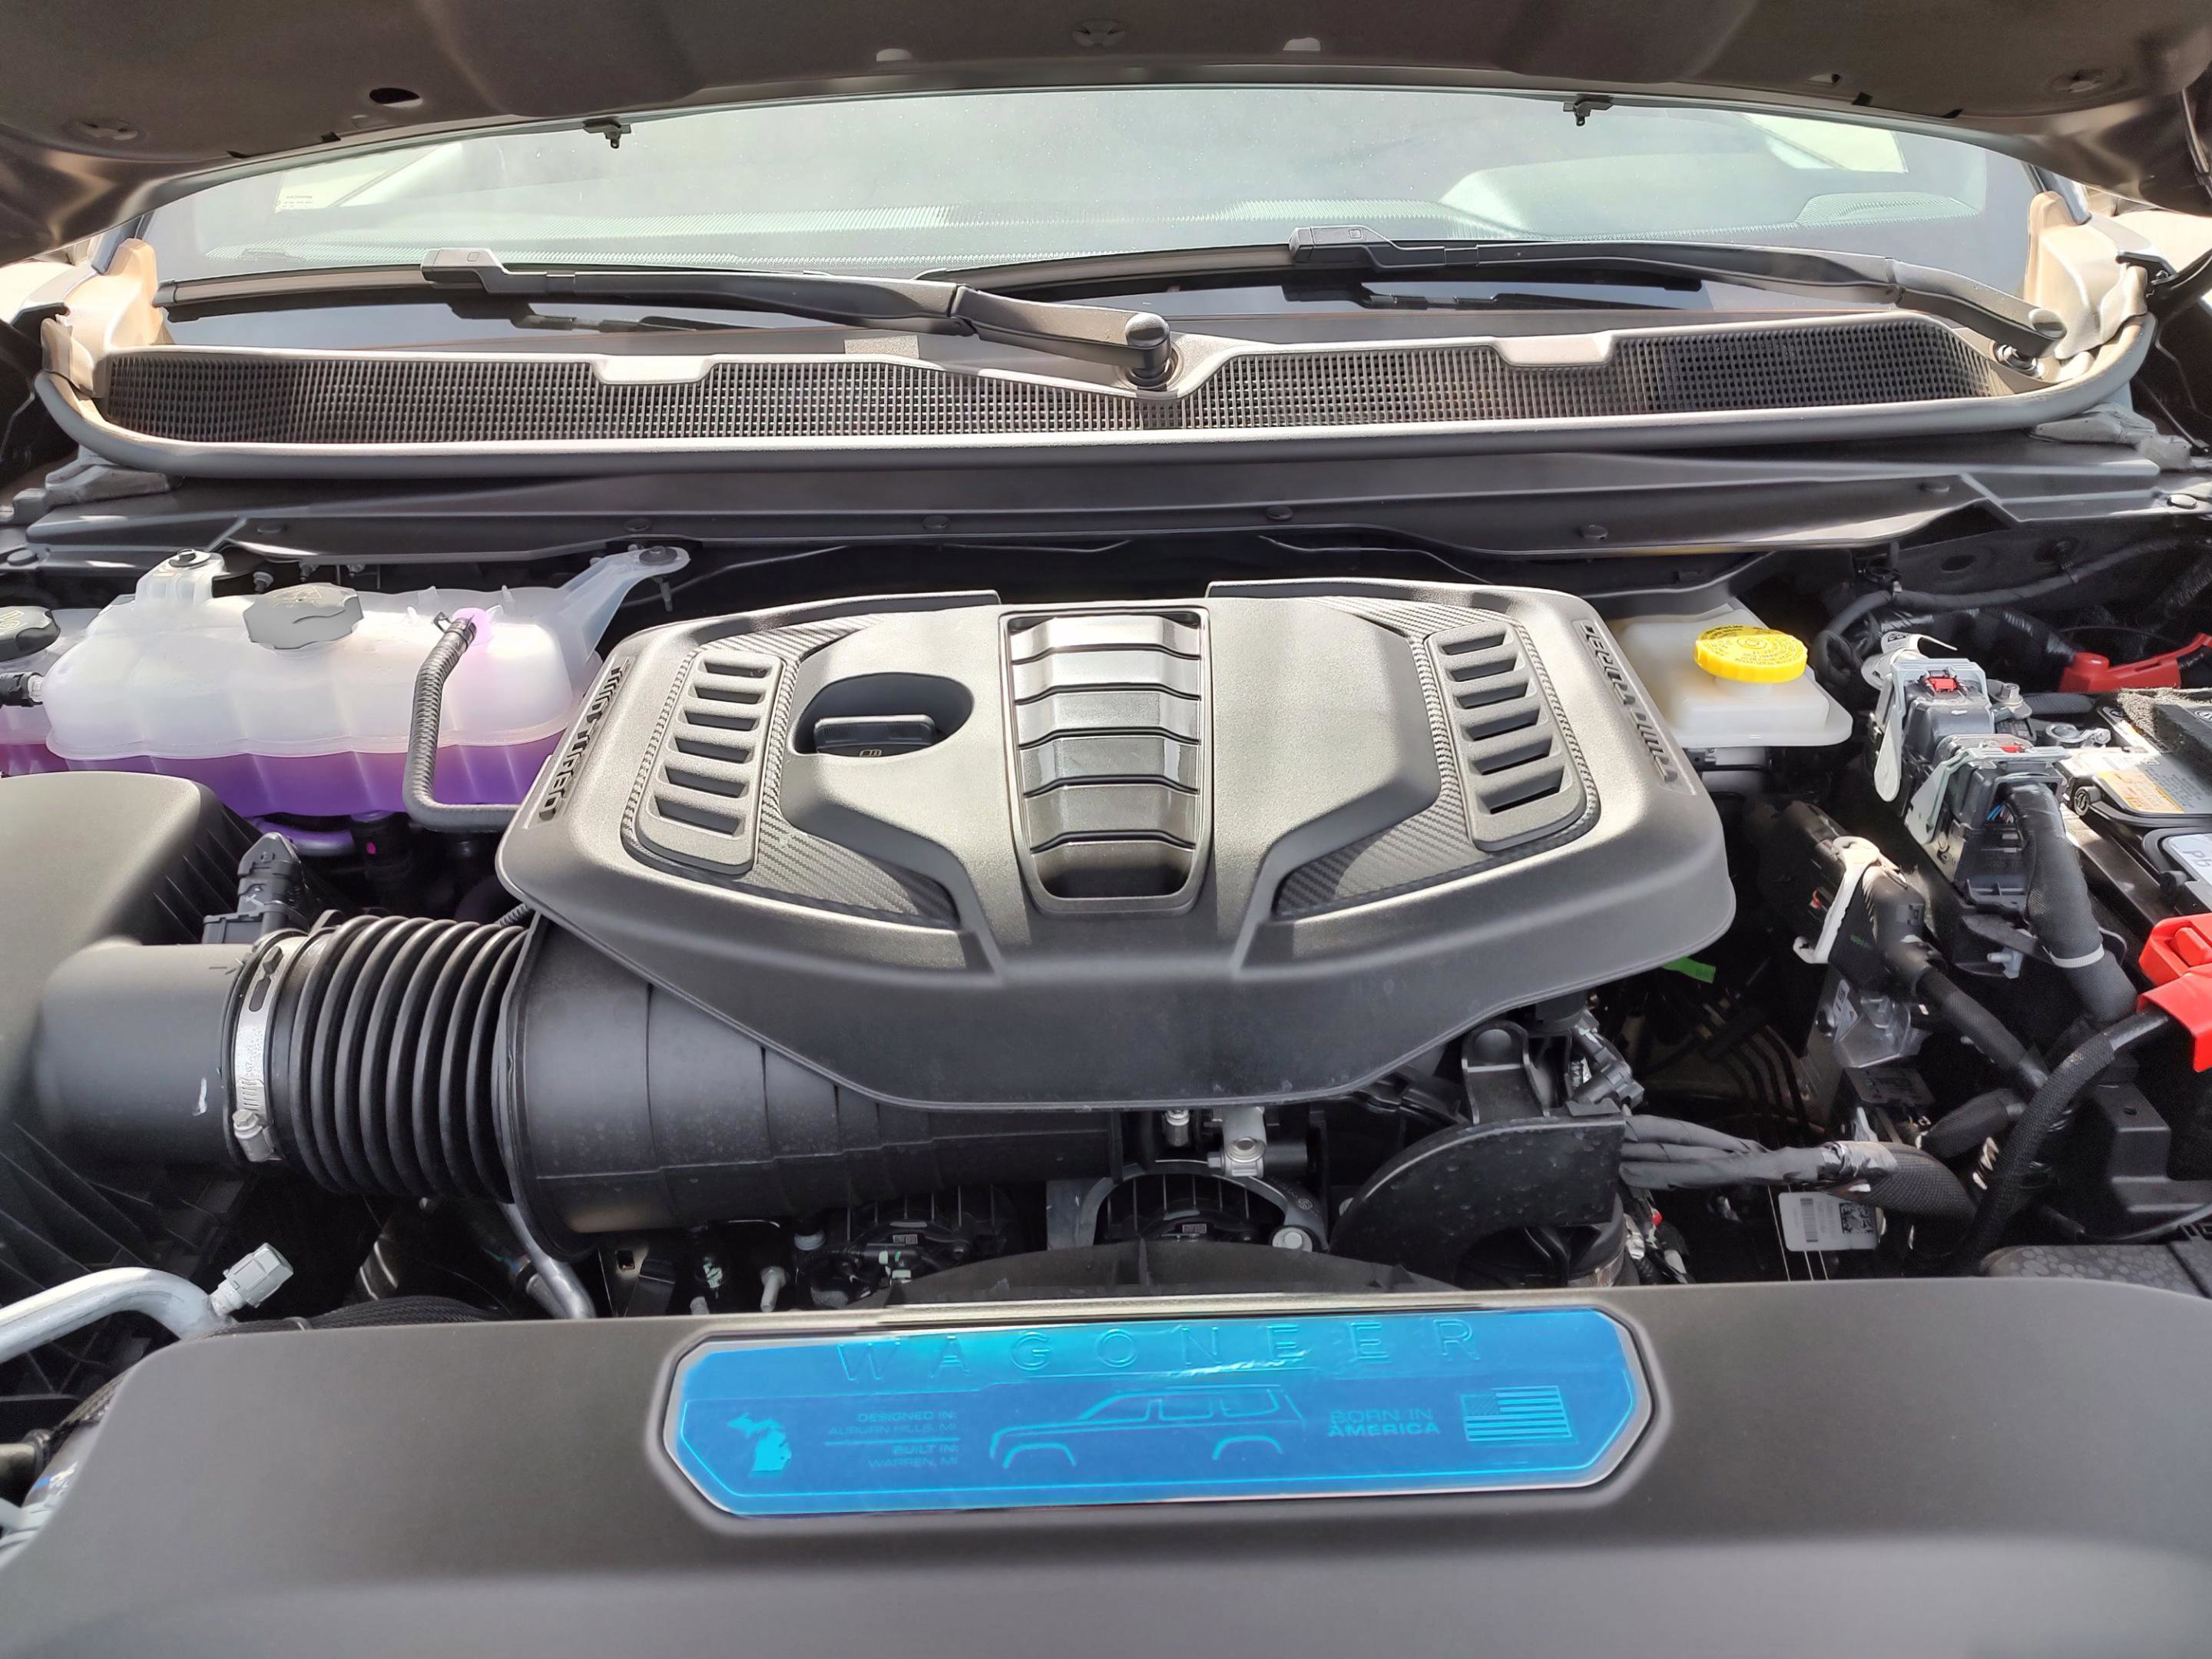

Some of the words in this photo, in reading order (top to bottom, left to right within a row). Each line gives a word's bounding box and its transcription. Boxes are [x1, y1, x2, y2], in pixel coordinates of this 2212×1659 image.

[1579, 620, 1636, 706] TURBO
[539, 716, 598, 821] TURBO
[836, 1318, 1481, 1381] WAGONEER
[856, 1411, 934, 1422] DESIGNED
[1329, 1408, 1400, 1424] BORN
[1409, 1408, 1434, 1420] IN
[827, 1425, 889, 1435] AUBURN
[1328, 1422, 1442, 1437] AMERICA
[892, 1444, 935, 1455] BUILT
